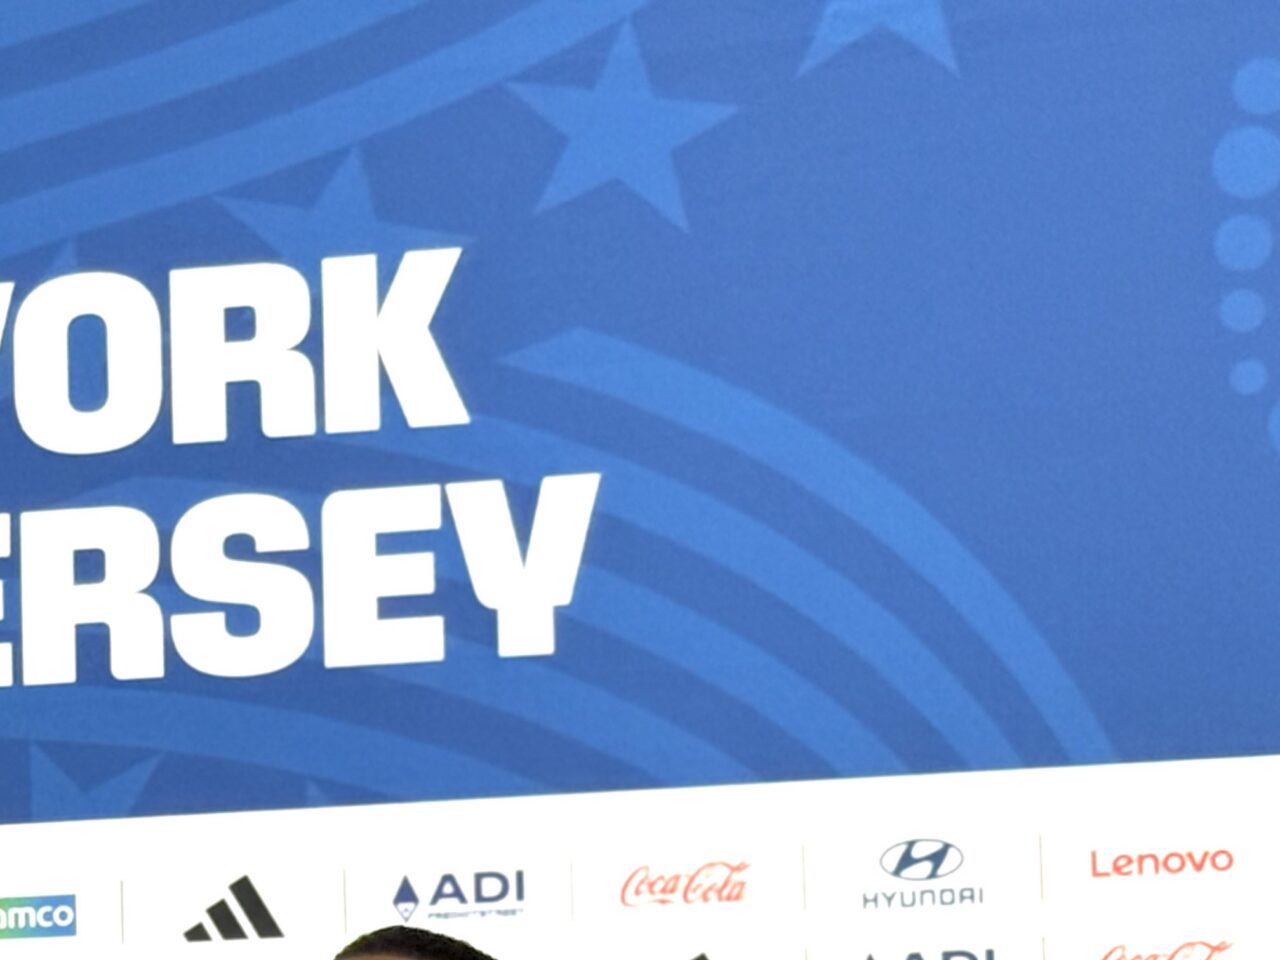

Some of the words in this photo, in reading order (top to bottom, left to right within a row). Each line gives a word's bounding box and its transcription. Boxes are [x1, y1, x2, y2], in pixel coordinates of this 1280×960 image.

[1090, 849, 1235, 879] Lenovo
[429, 869, 525, 906] ADI
[619, 860, 750, 907] Coca-Cola
[862, 887, 984, 909] HYUNDAI
